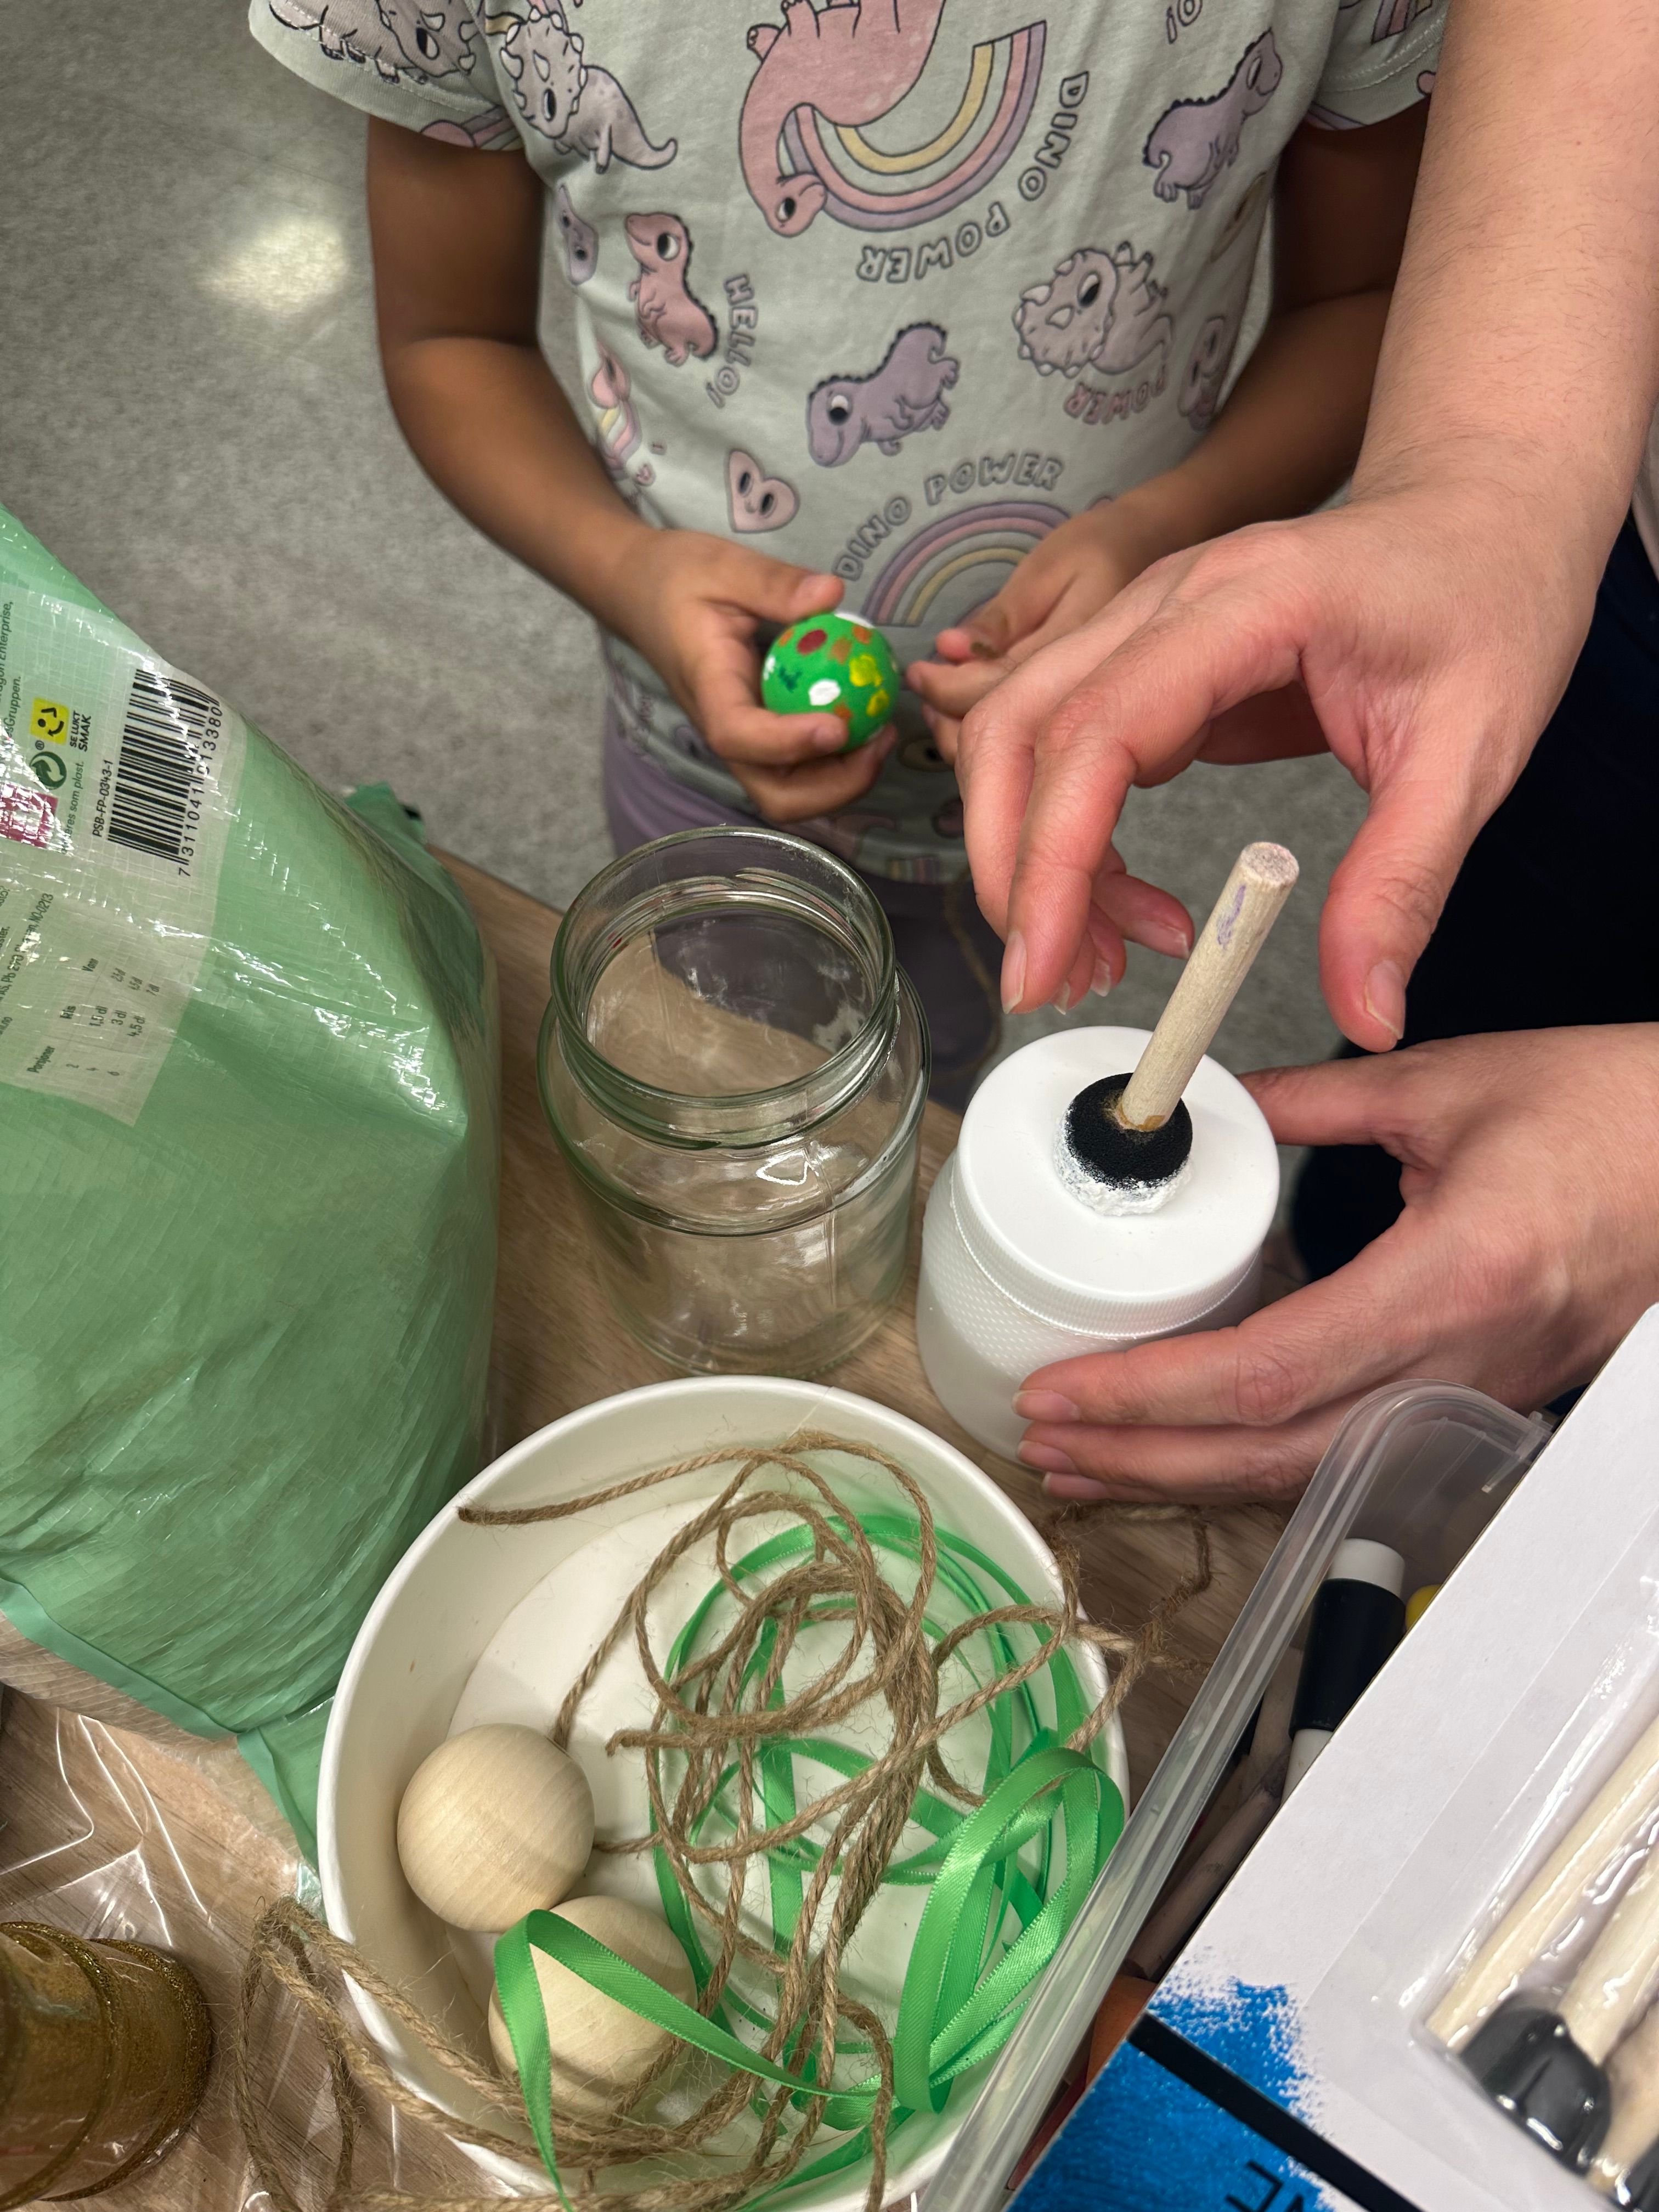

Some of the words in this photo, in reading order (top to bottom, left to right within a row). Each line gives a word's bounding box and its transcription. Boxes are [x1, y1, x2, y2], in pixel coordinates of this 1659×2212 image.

[1019, 71, 1090, 201] DINO
[856, 201, 1011, 283] POWER
[833, 496, 912, 581] DINO
[924, 453, 1064, 506] POWER
[71, 710, 81, 733] LUKT
[78, 714, 92, 752] SMAK
[70, 734, 78, 748] SE
[196, 706, 223, 775] 013380
[72, 761, 84, 789] plast.
[70, 790, 80, 815] som
[92, 759, 114, 837] PSB-FP-0343-1
[182, 787, 205, 857] 311041
[178, 867, 191, 877] 7
[1, 972, 15, 983] Pb
[29, 892, 53, 923] NO-0213
[27, 1046, 55, 1073] Porsjoner
[60, 1005, 76, 1019] Ris
[82, 957, 99, 973] Vann
[96, 1005, 108, 1015] dl
[111, 1018, 124, 1026] 3
[115, 1010, 127, 1019] dl
[134, 1015, 146, 1025] dl
[127, 1024, 143, 1037] 4,5
